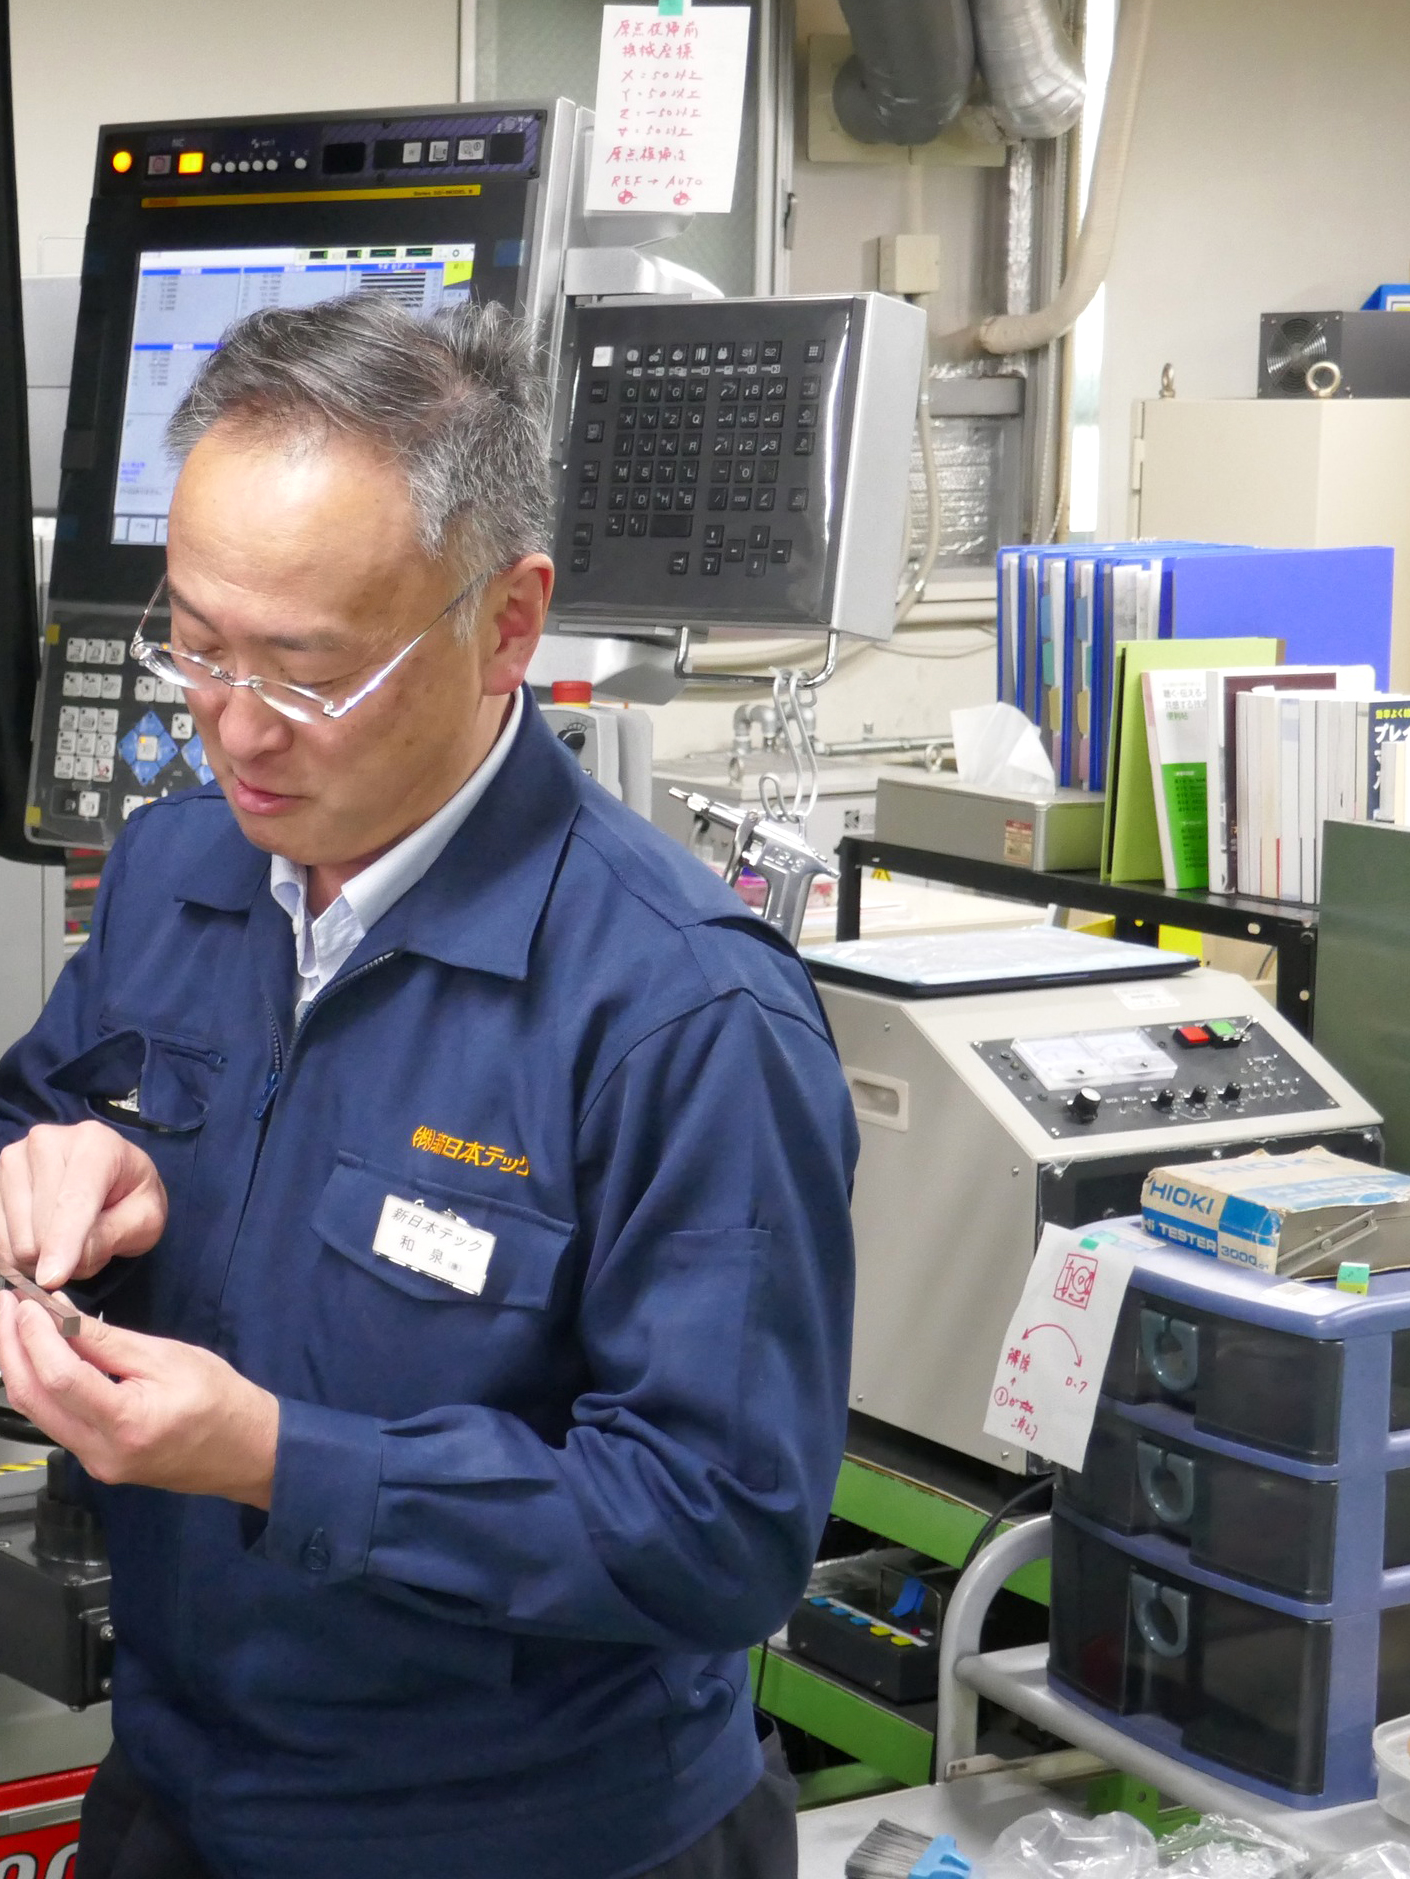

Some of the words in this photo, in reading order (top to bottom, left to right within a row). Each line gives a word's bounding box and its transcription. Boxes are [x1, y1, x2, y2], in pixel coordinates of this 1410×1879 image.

[611, 175, 643, 188] REF
[665, 175, 703, 189] AUTO
[742, 348, 752, 357] S1
[764, 348, 776, 357] S2
[672, 387, 680, 397] G
[695, 386, 703, 396] P
[692, 414, 700, 424] Q
[1150, 1180, 1215, 1215] HIOKI
[391, 1206, 483, 1254] 新日本テック
[1158, 1222, 1218, 1253] TESTER
